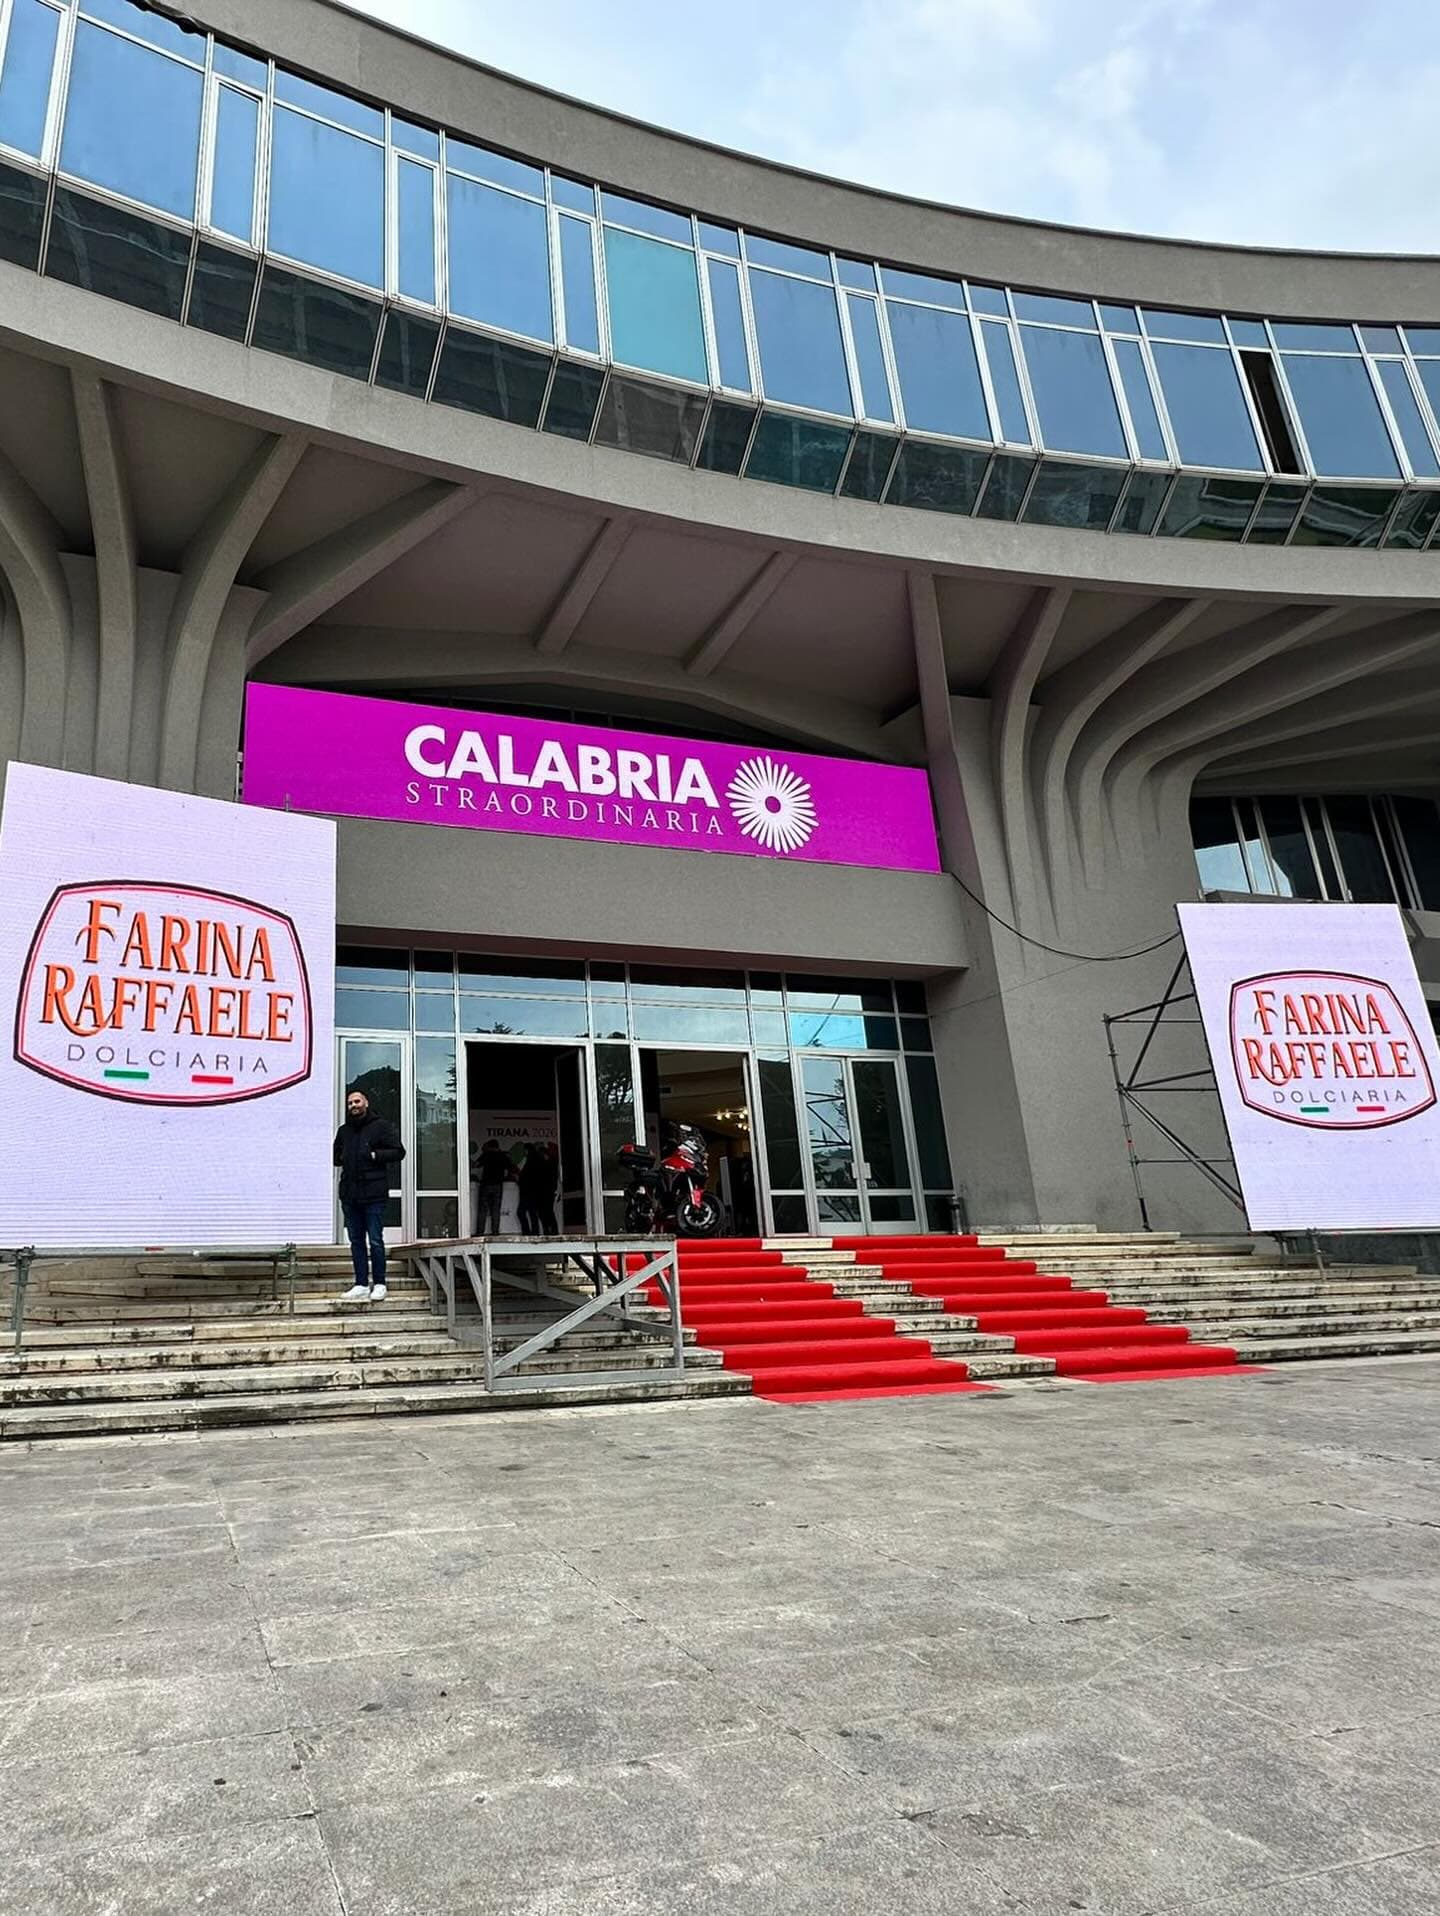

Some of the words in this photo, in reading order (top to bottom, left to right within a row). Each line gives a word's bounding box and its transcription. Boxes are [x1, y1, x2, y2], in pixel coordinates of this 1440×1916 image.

[404, 724, 720, 808] CALABRIA
[406, 782, 723, 836] STRAORDINARIA
[75, 900, 276, 982] FARINA
[39, 964, 295, 1042] RAFFAELE
[1253, 990, 1391, 1035] FARINA
[67, 1044, 269, 1073] DOLCIARIA
[1242, 1038, 1416, 1086] RAFFAELE
[1273, 1090, 1407, 1104] DOLCIARIA
[486, 1127, 529, 1138] TIRANA
